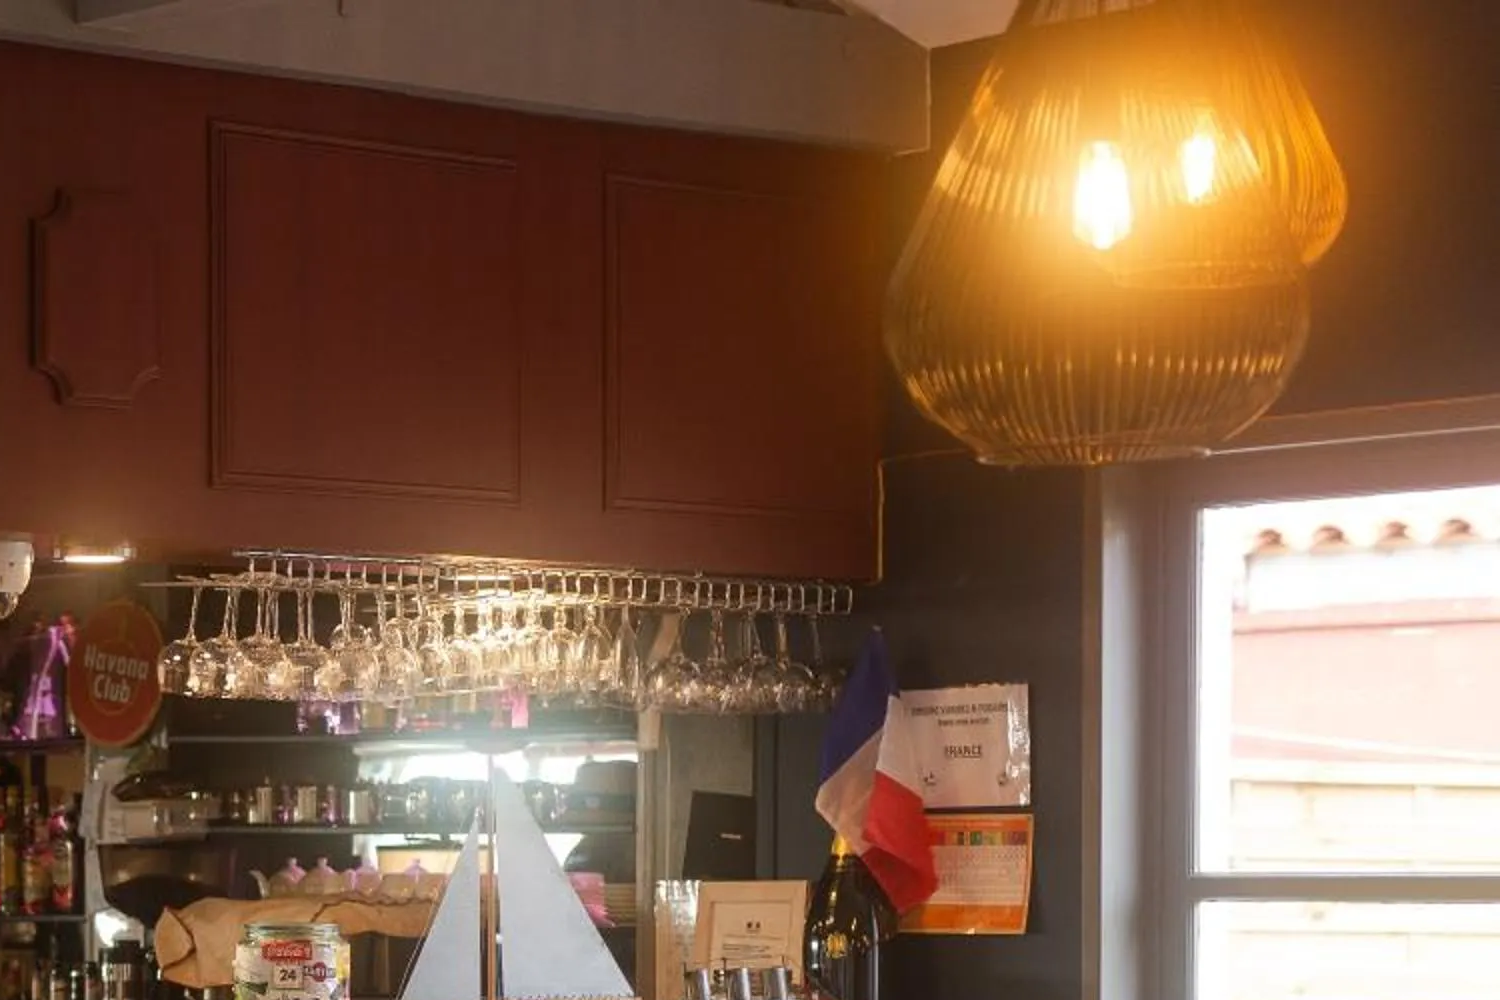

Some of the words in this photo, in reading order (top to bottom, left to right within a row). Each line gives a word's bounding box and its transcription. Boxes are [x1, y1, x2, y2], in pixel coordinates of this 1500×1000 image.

[84, 645, 150, 681] Havana
[93, 674, 132, 703] Club
[279, 968, 297, 982] 24
